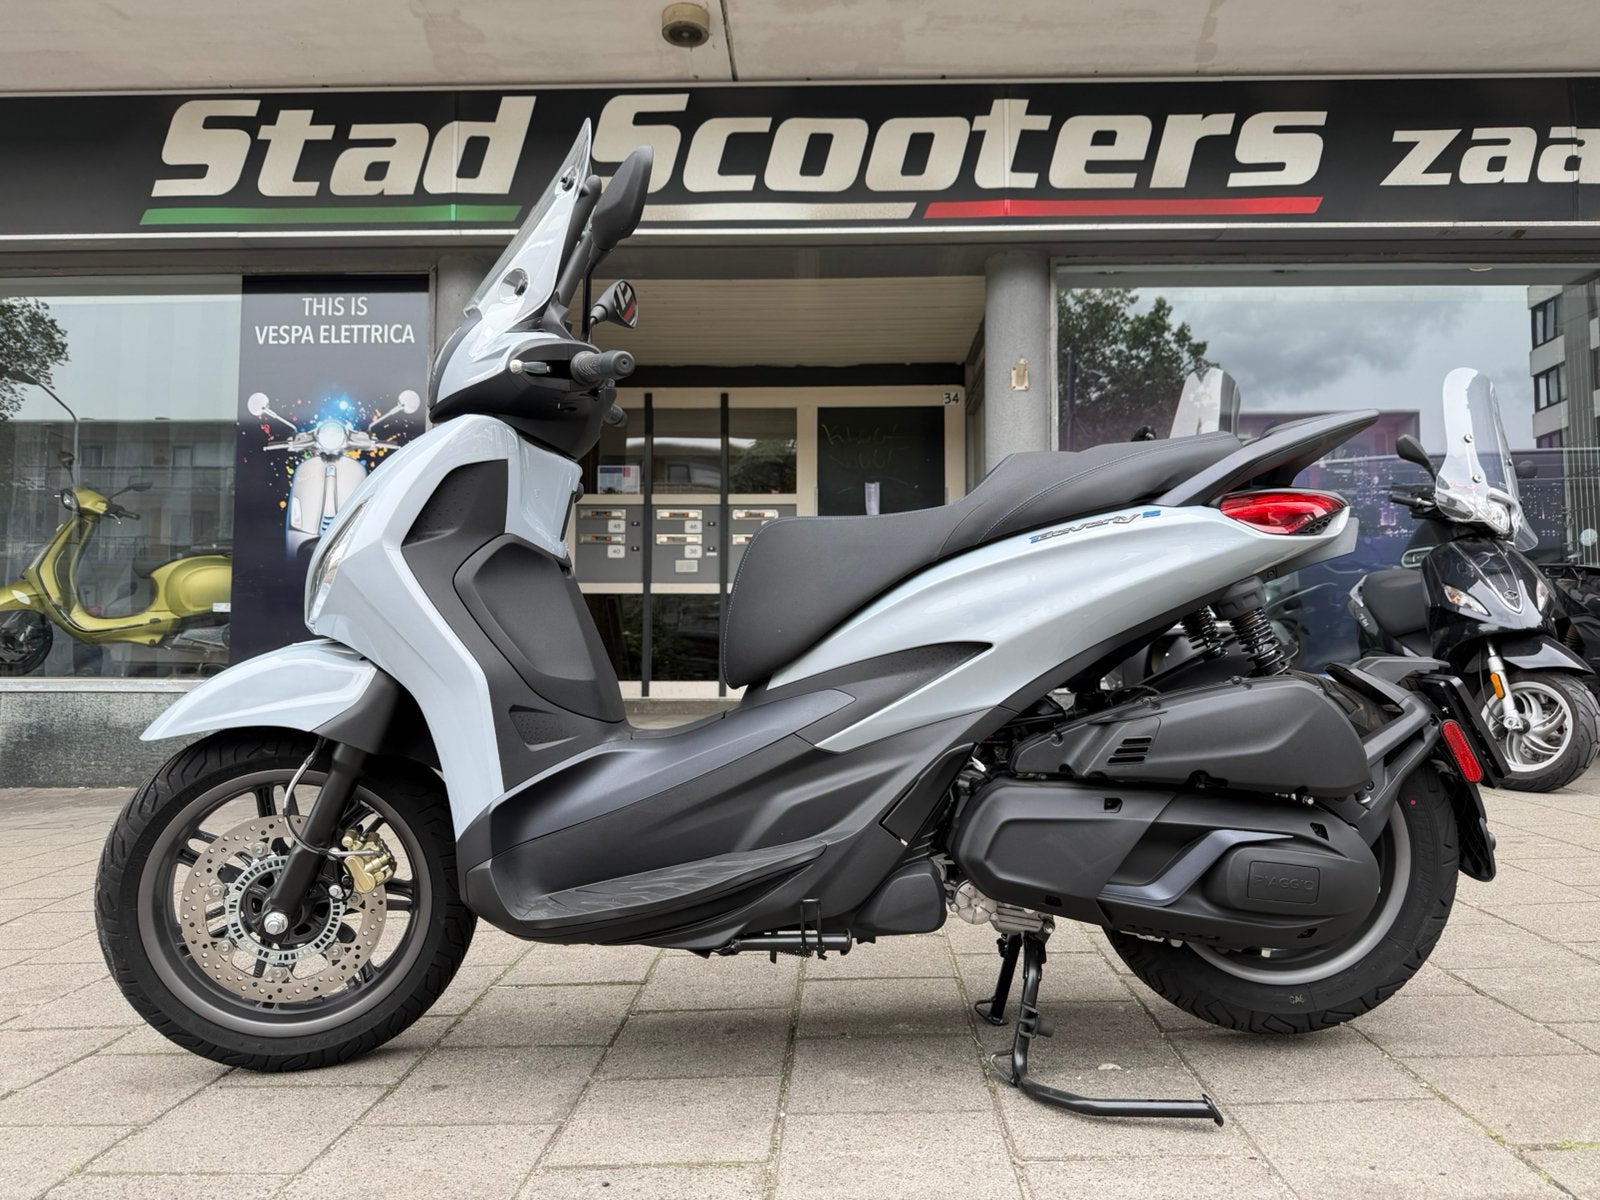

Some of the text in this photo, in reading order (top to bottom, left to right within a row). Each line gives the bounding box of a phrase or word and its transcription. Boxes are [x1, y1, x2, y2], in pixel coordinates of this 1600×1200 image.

[150, 95, 537, 198] Stad
[591, 93, 1328, 195] Scooters
[302, 296, 368, 317] THIS IS
[254, 323, 416, 345] VESPA ELETTRICA
[944, 392, 959, 405] 34
[1253, 873, 1315, 891] PIAGGIO
